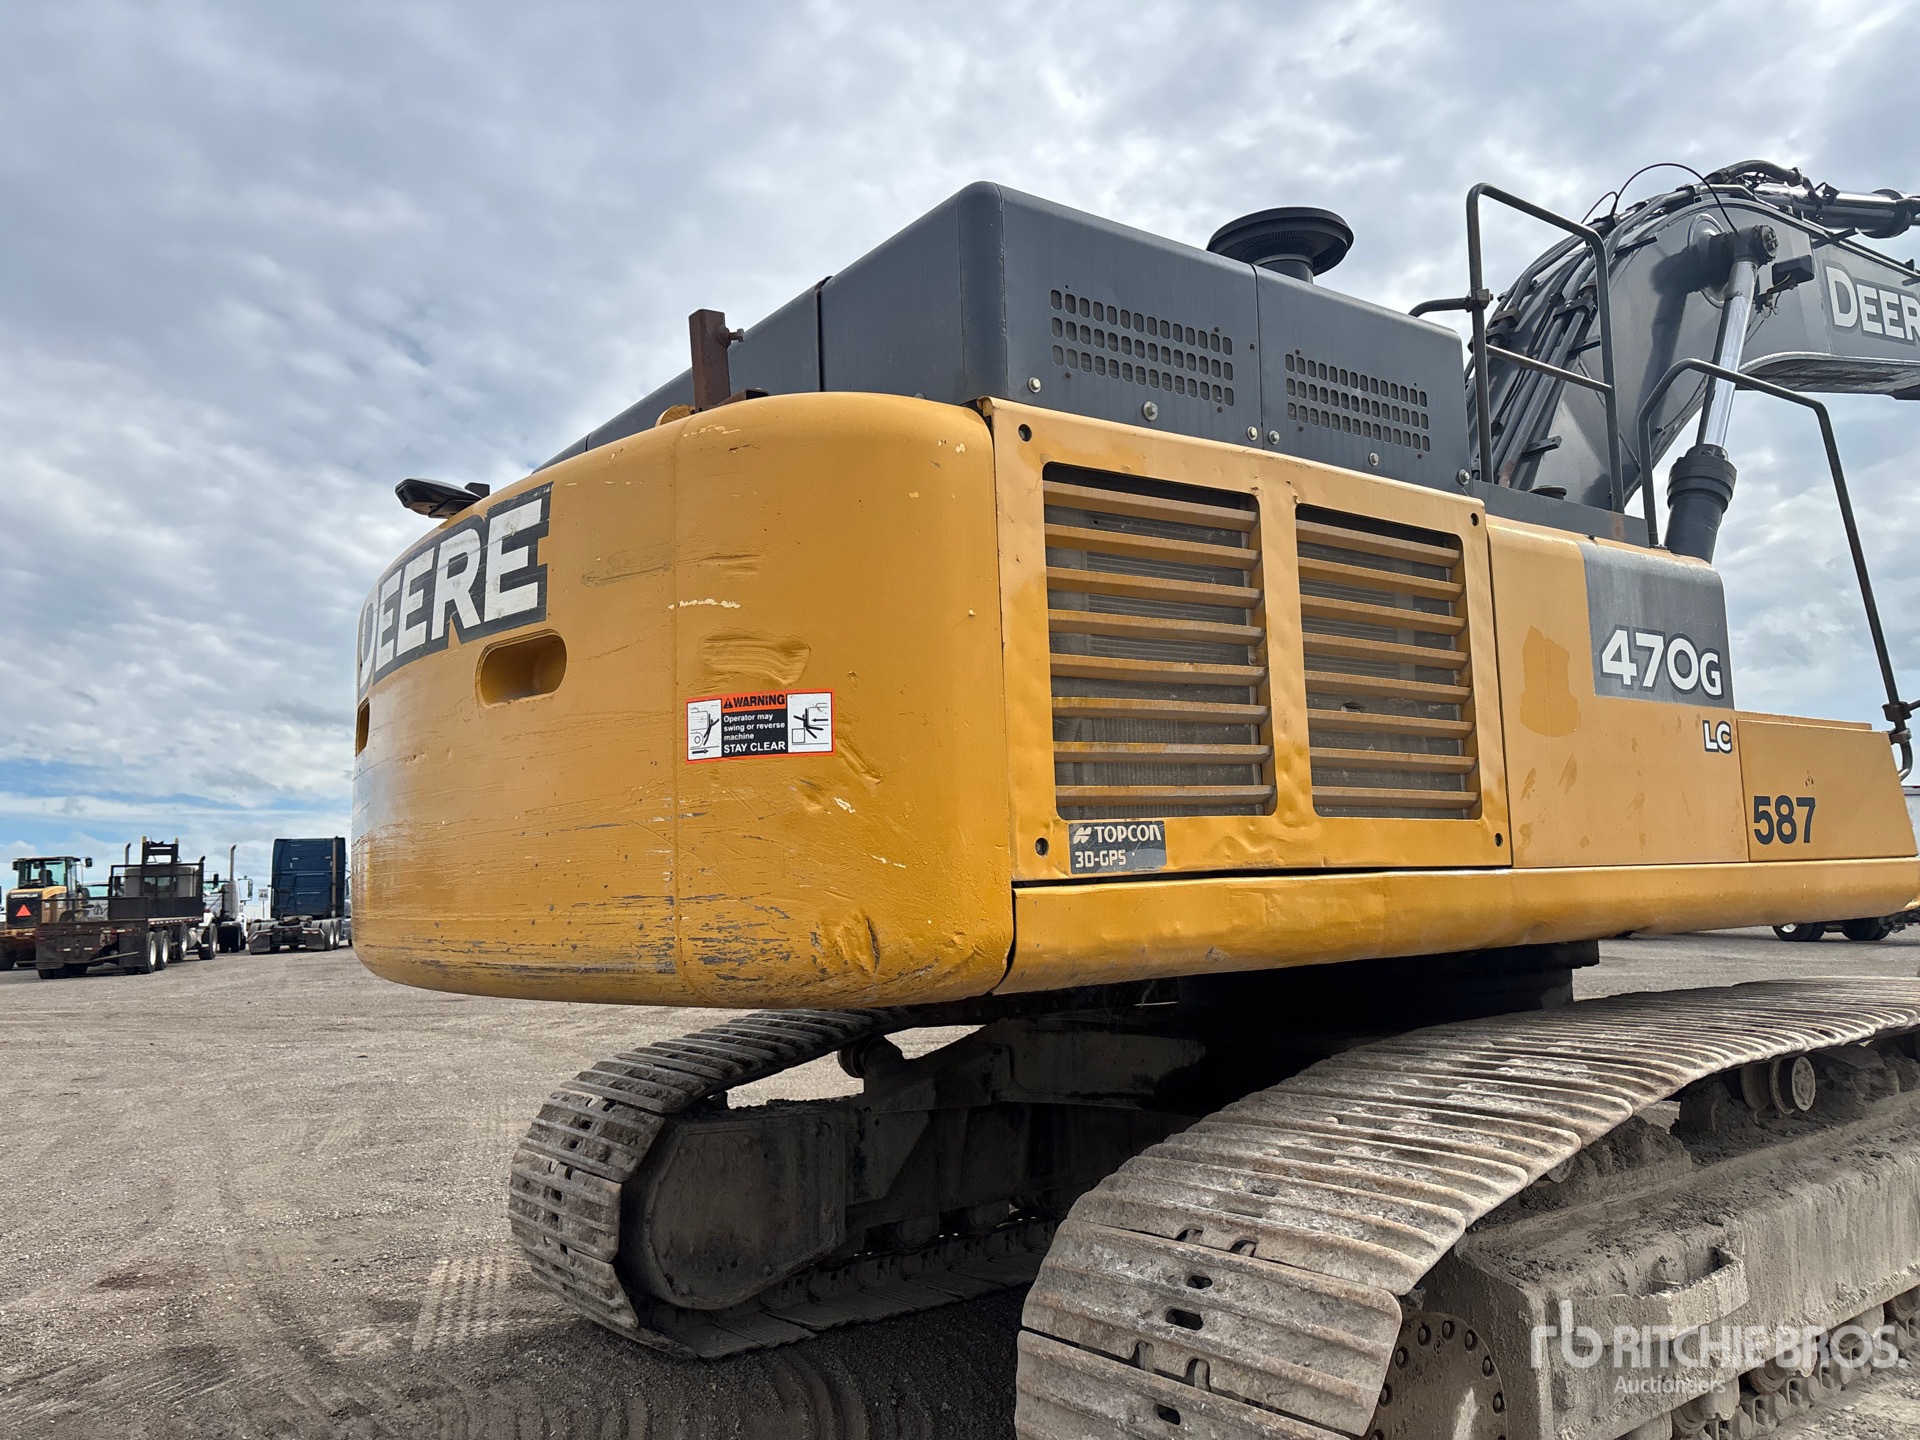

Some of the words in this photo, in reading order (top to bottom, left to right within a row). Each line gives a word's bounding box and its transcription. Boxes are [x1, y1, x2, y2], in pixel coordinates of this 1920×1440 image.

[360, 498, 542, 689] DEERE
[1601, 629, 1722, 696] 470G
[733, 694, 785, 707] WARNING
[723, 714, 755, 723] Operator
[757, 713, 773, 721] may
[723, 724, 745, 732] swing
[723, 733, 755, 741] machine
[1703, 722, 1732, 751] LC
[723, 743, 748, 754] STAY
[750, 740, 786, 752] CLEAR
[1753, 795, 1816, 845] 587
[1094, 824, 1162, 843] TOPCON
[1075, 849, 1127, 868] 3D-GPS
